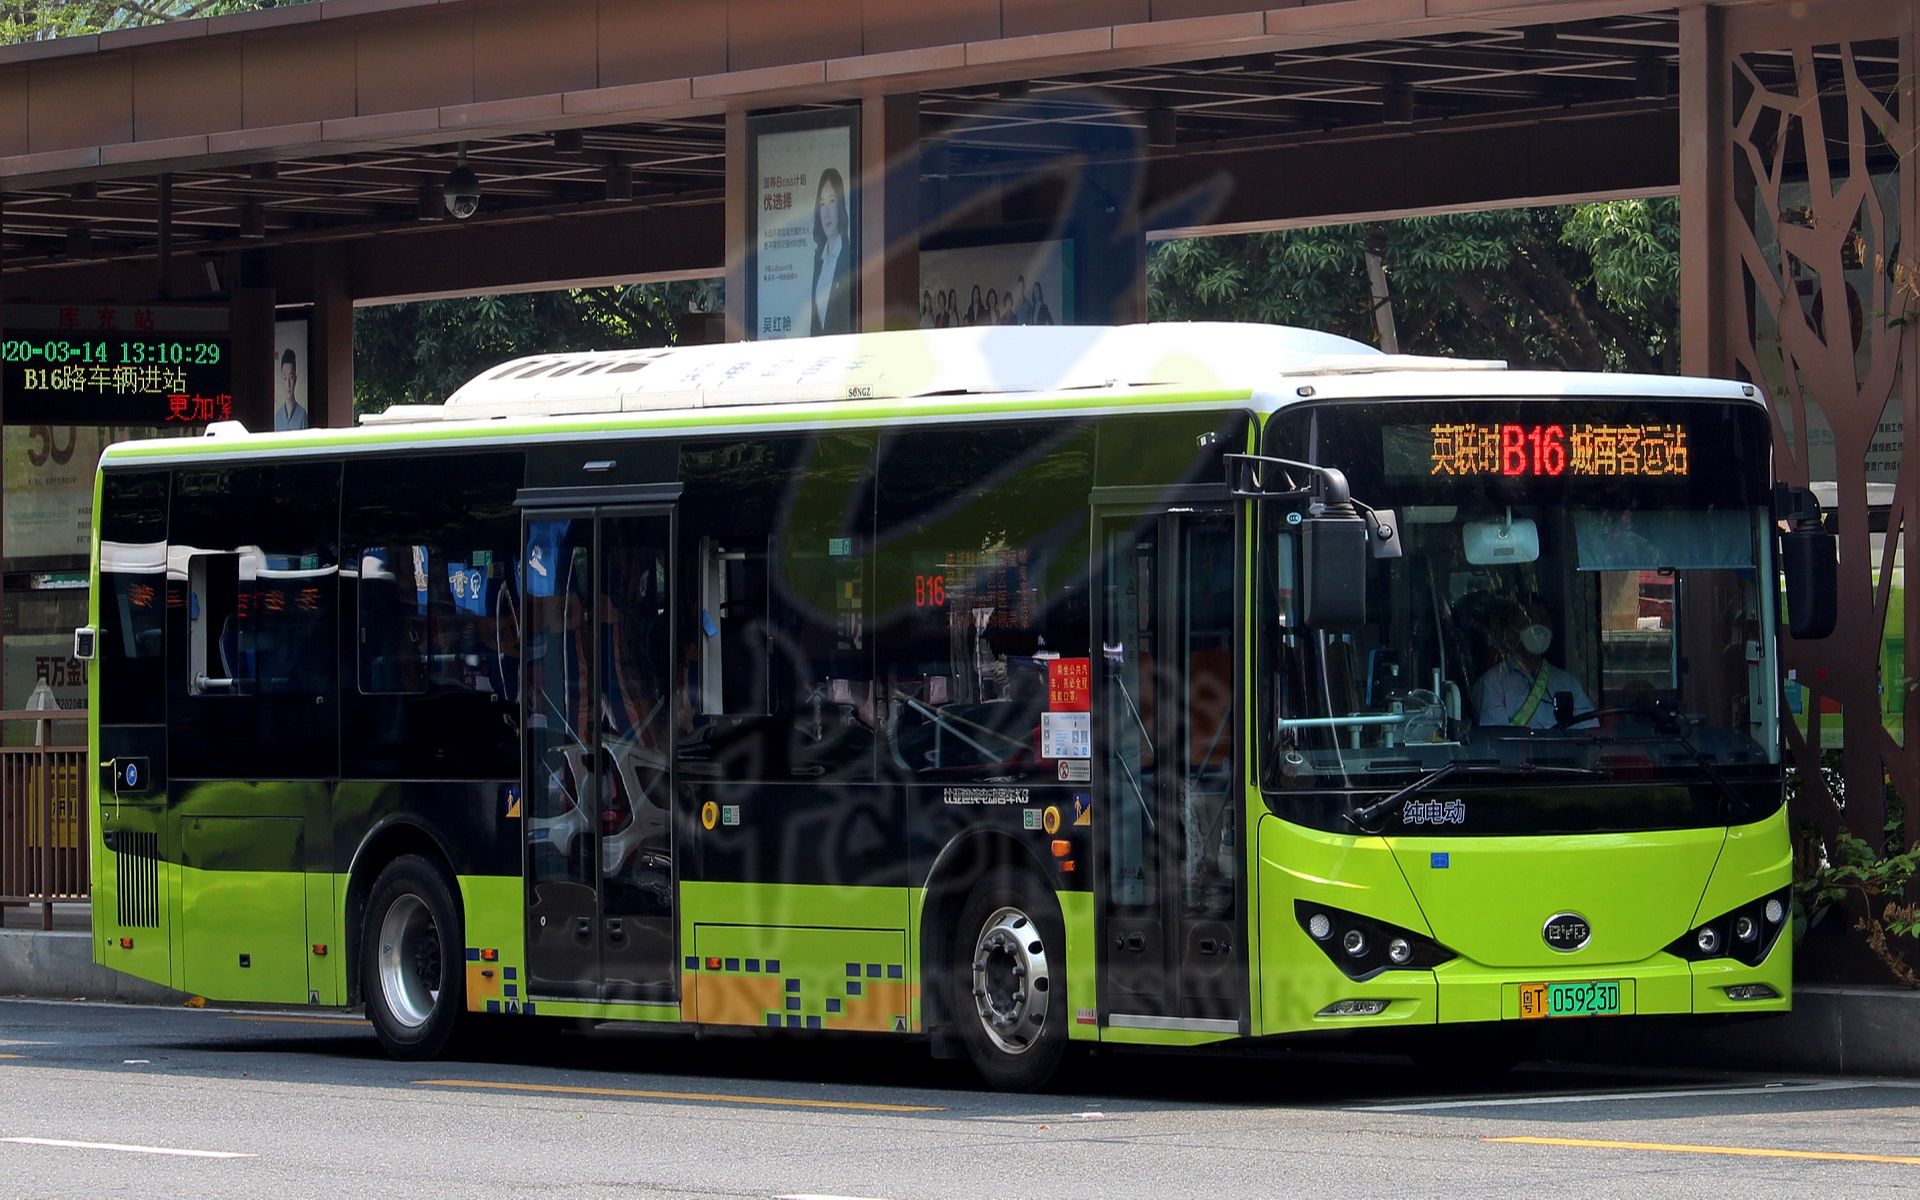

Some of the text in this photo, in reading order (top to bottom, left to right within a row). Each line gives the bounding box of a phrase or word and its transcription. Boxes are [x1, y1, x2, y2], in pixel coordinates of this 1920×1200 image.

[120, 342, 220, 364] 13:10:29
[24, 364, 187, 394] B16路车辆进站
[848, 386, 872, 397] SONGZ
[1501, 424, 1565, 476] B16
[1570, 424, 1688, 475] 城南客运站
[916, 575, 945, 607] B16
[1402, 798, 1466, 824] 纯电动
[1548, 923, 1586, 940] BYD
[1523, 986, 1618, 1013] 粤T 05923D
